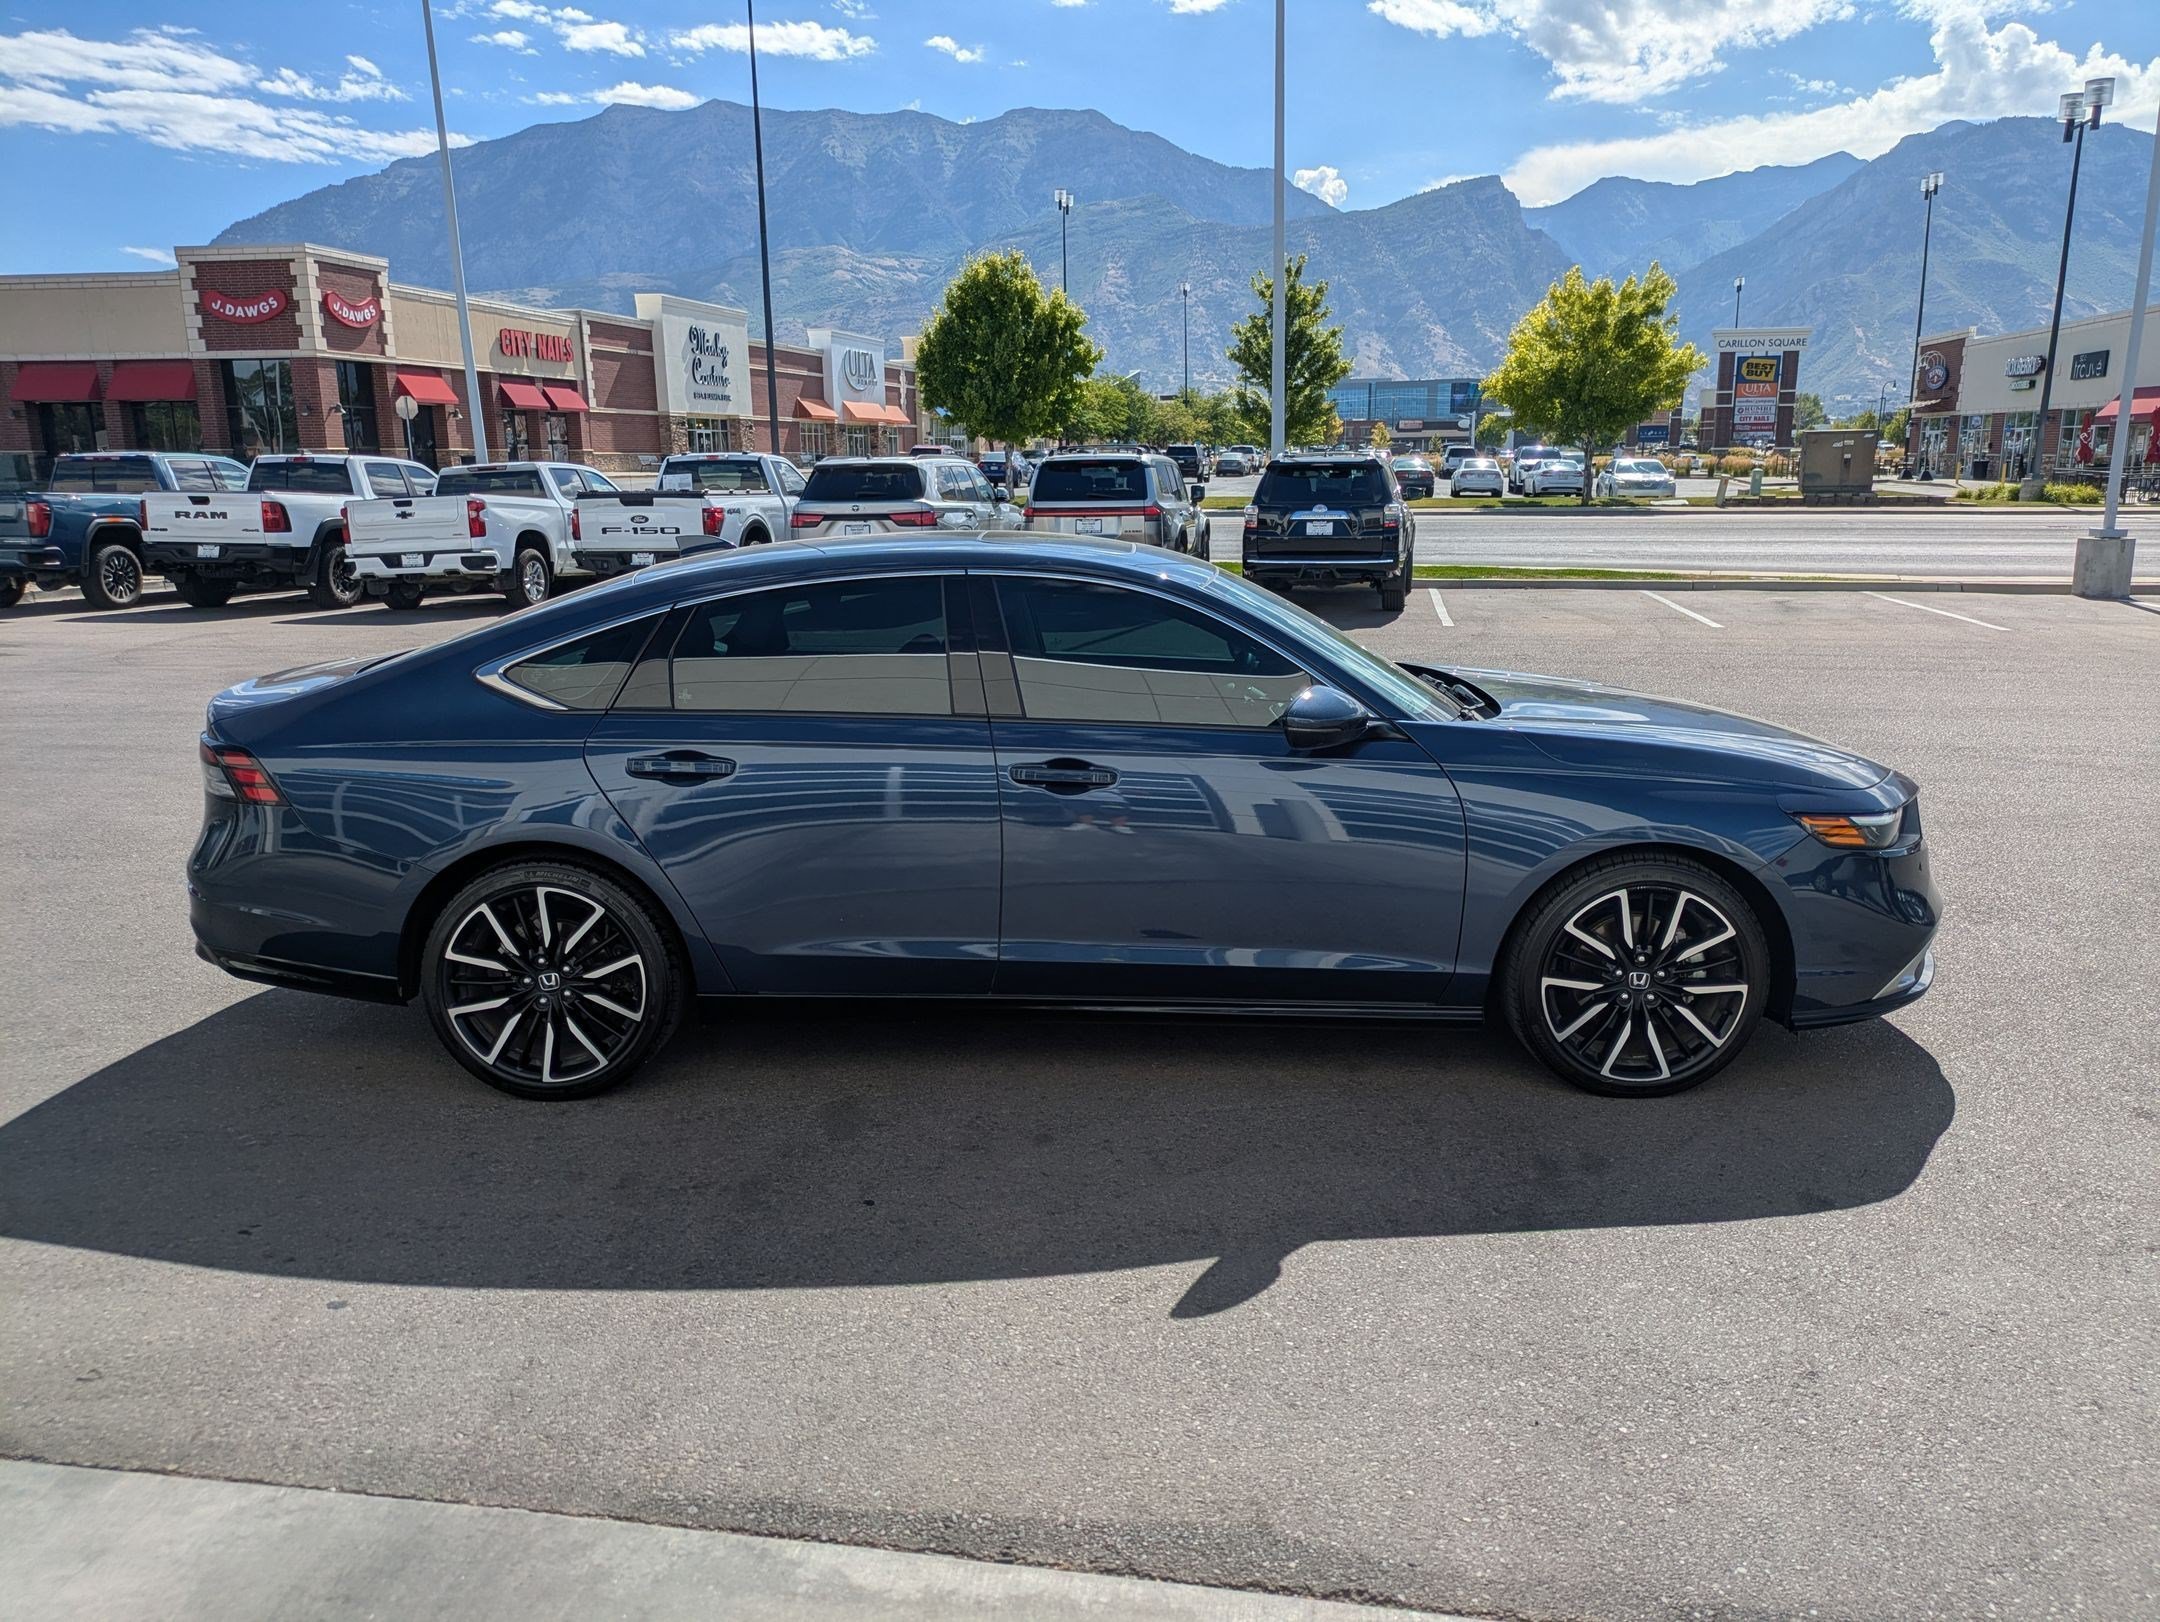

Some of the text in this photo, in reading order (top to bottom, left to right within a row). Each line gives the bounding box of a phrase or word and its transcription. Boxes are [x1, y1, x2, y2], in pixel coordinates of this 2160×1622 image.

[211, 296, 279, 318] J.DAWGS
[333, 301, 377, 322] J.DAWGS
[500, 328, 574, 363] CITY NAILS
[1718, 338, 1808, 348] CARILLON SQUARE
[848, 350, 876, 379] ULTA
[1746, 362, 1775, 370] BEST
[1745, 383, 1771, 393] ULTA
[174, 511, 228, 519] RAM
[601, 526, 680, 534] F-150
